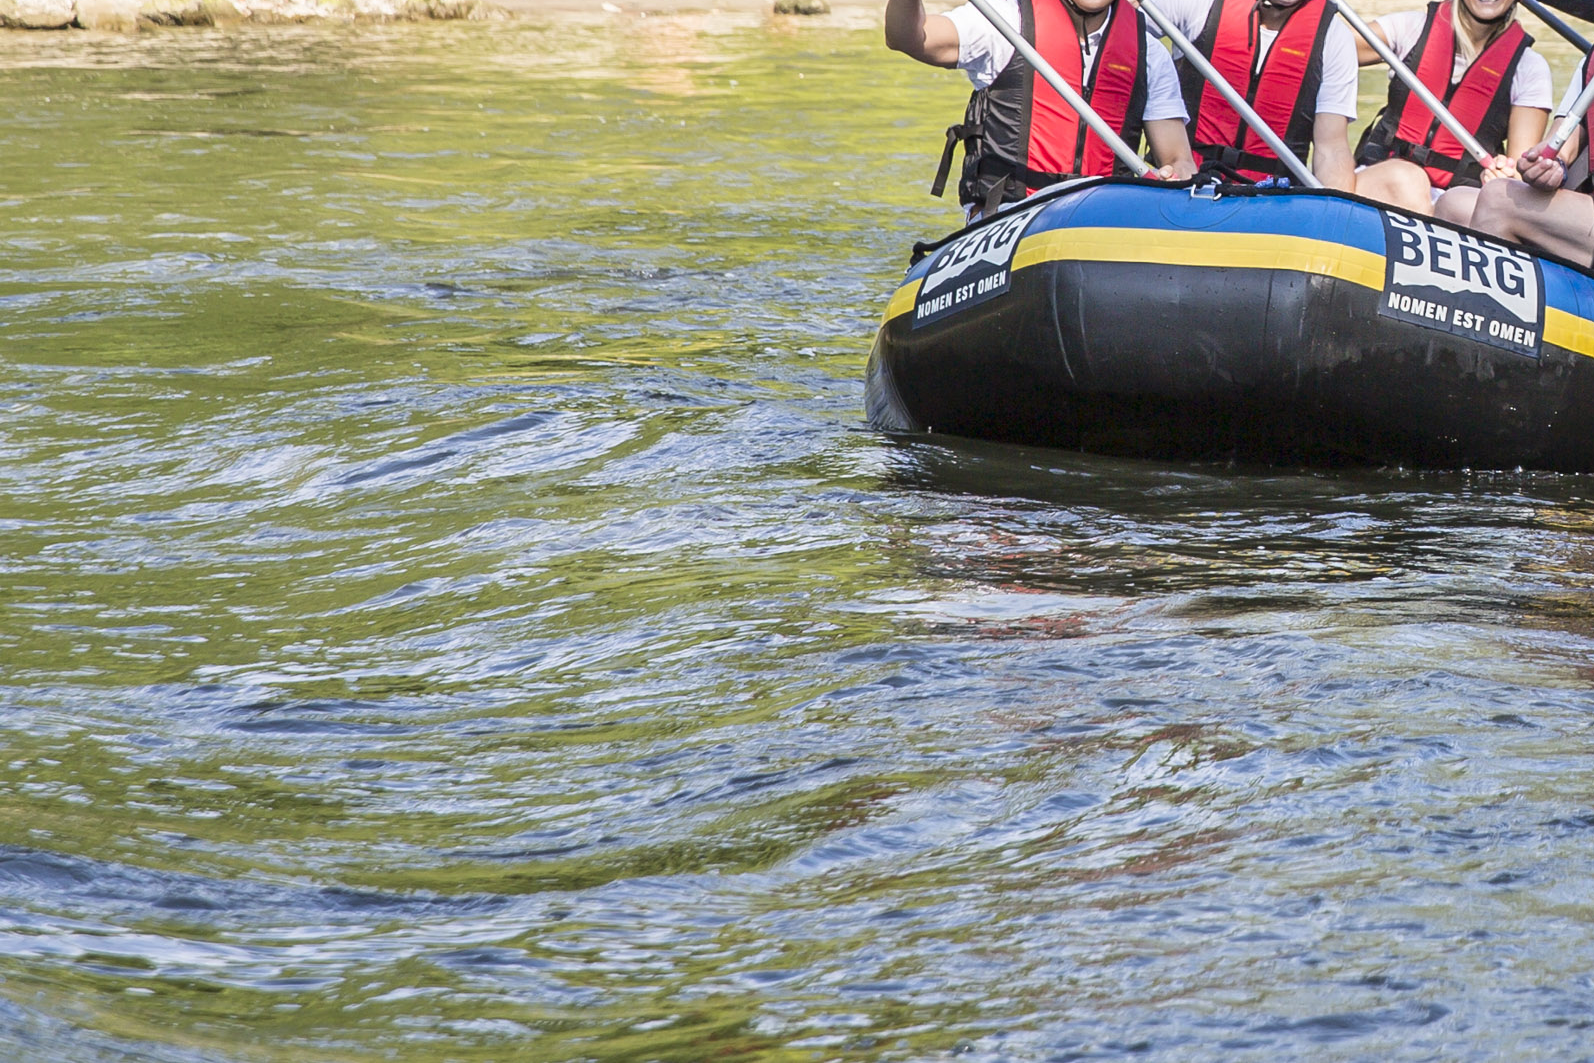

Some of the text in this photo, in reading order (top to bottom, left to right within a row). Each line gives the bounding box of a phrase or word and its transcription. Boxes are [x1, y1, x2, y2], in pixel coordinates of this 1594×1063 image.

[931, 211, 1027, 273] BERG
[1395, 228, 1526, 298] BERG
[917, 270, 1006, 319] NOMEN EST OMEN
[1388, 292, 1536, 348] NOMEN EST OMEN
